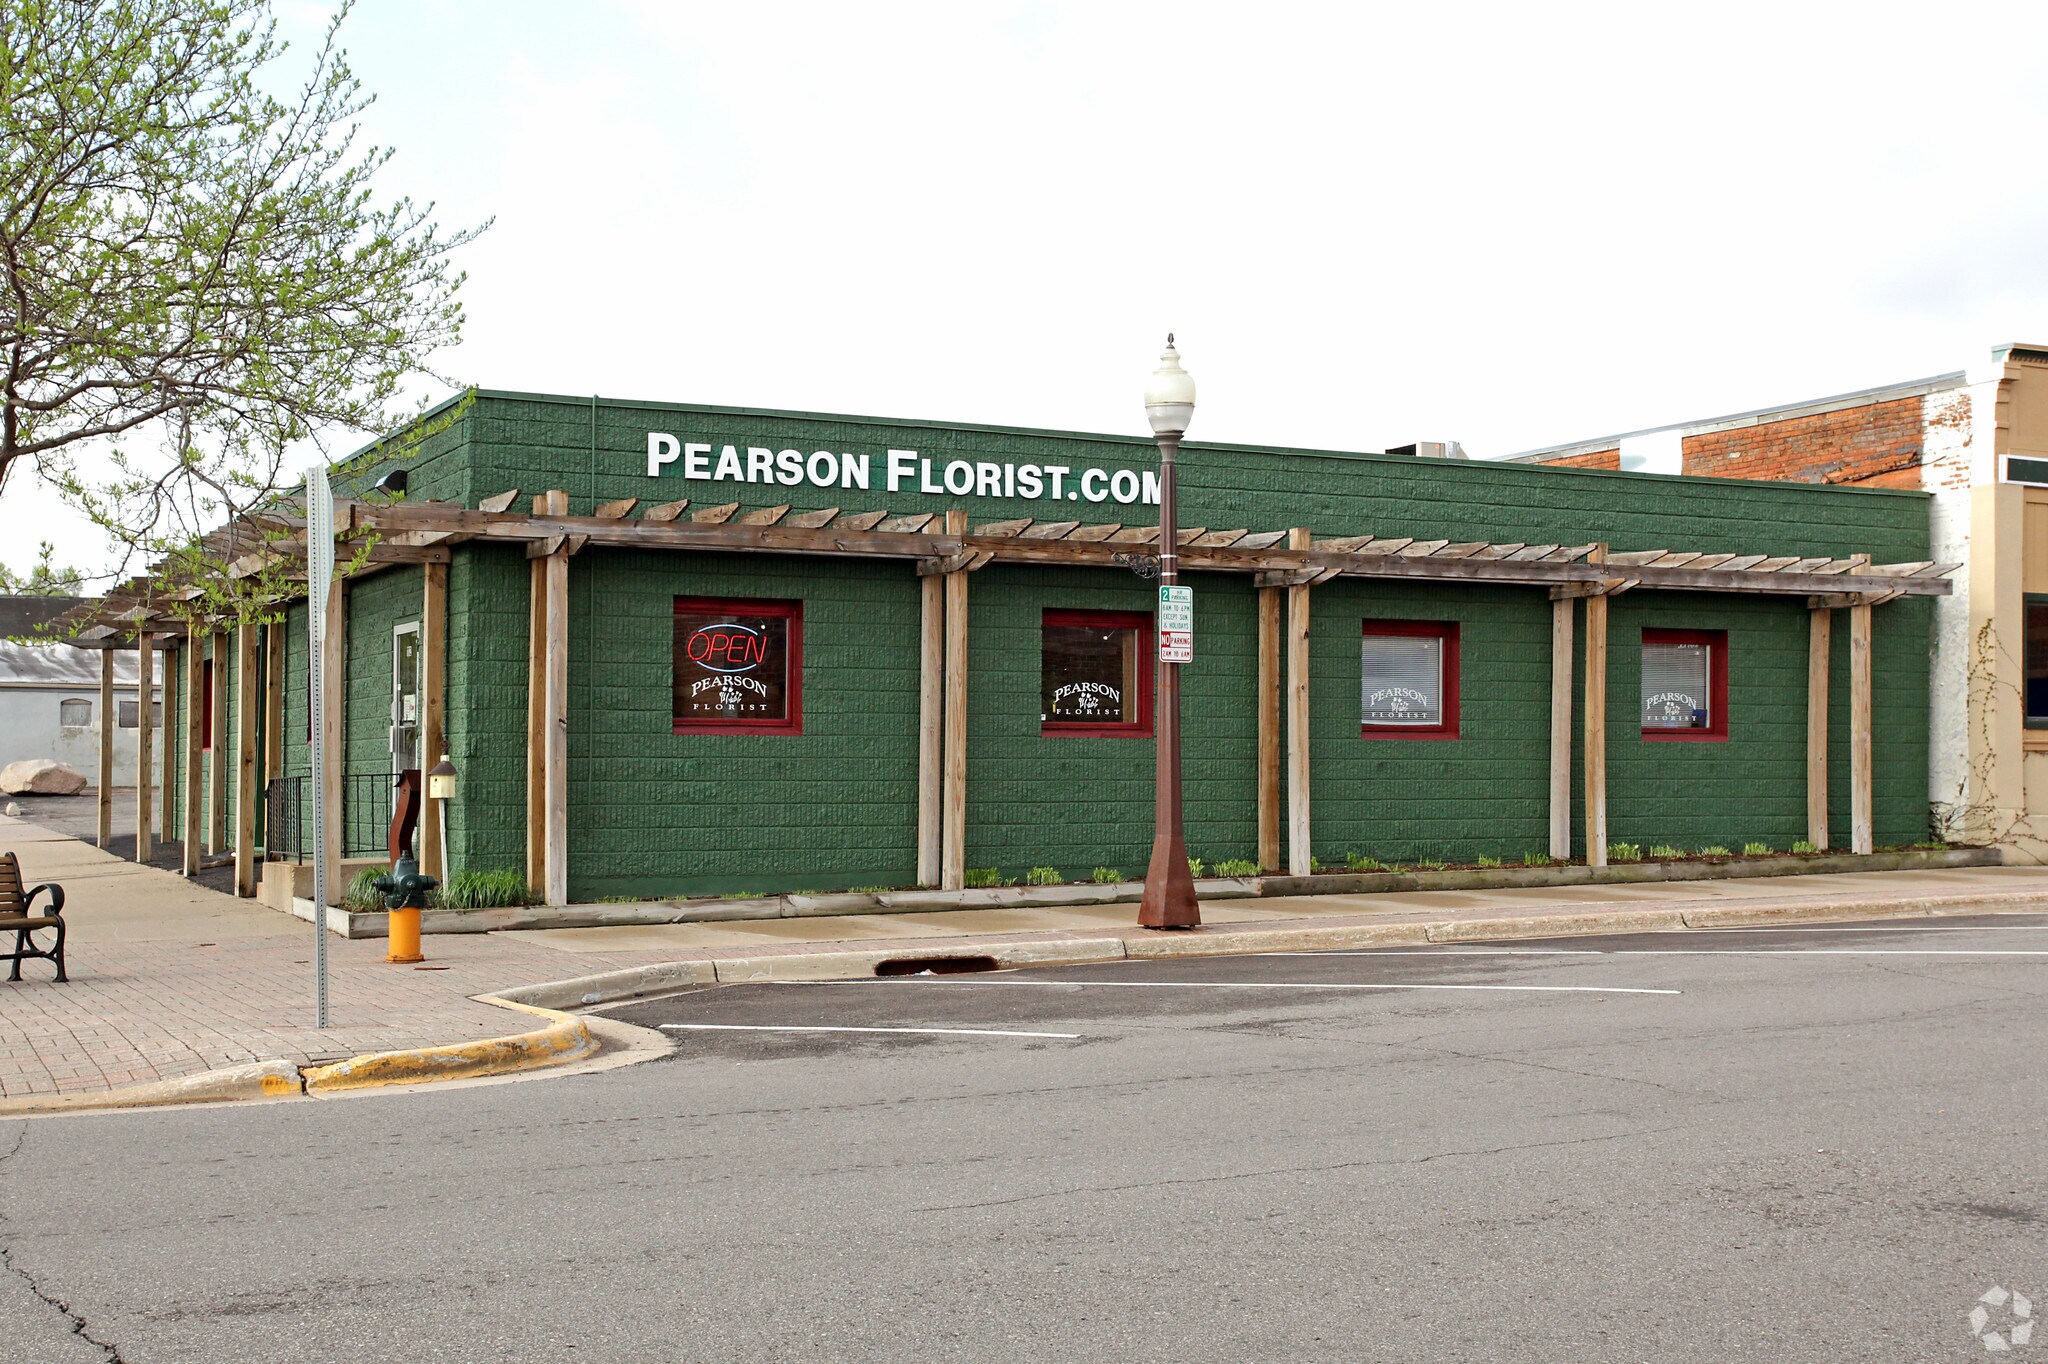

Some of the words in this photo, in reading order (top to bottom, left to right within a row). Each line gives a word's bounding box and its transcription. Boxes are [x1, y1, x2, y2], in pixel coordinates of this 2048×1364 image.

[647, 432, 870, 491] PEARSON
[886, 449, 1162, 505] FLORIST.COM
[1162, 590, 1169, 601] 2
[687, 632, 767, 663] OPEN
[1161, 634, 1170, 646] NO
[1171, 637, 1190, 645] PARKING
[691, 675, 767, 698] PEARSON
[1054, 682, 1120, 703] PEARSON
[693, 703, 767, 711] FLORIST
[1370, 687, 1427, 707] PEARSON
[1646, 692, 1697, 710] PEARSON
